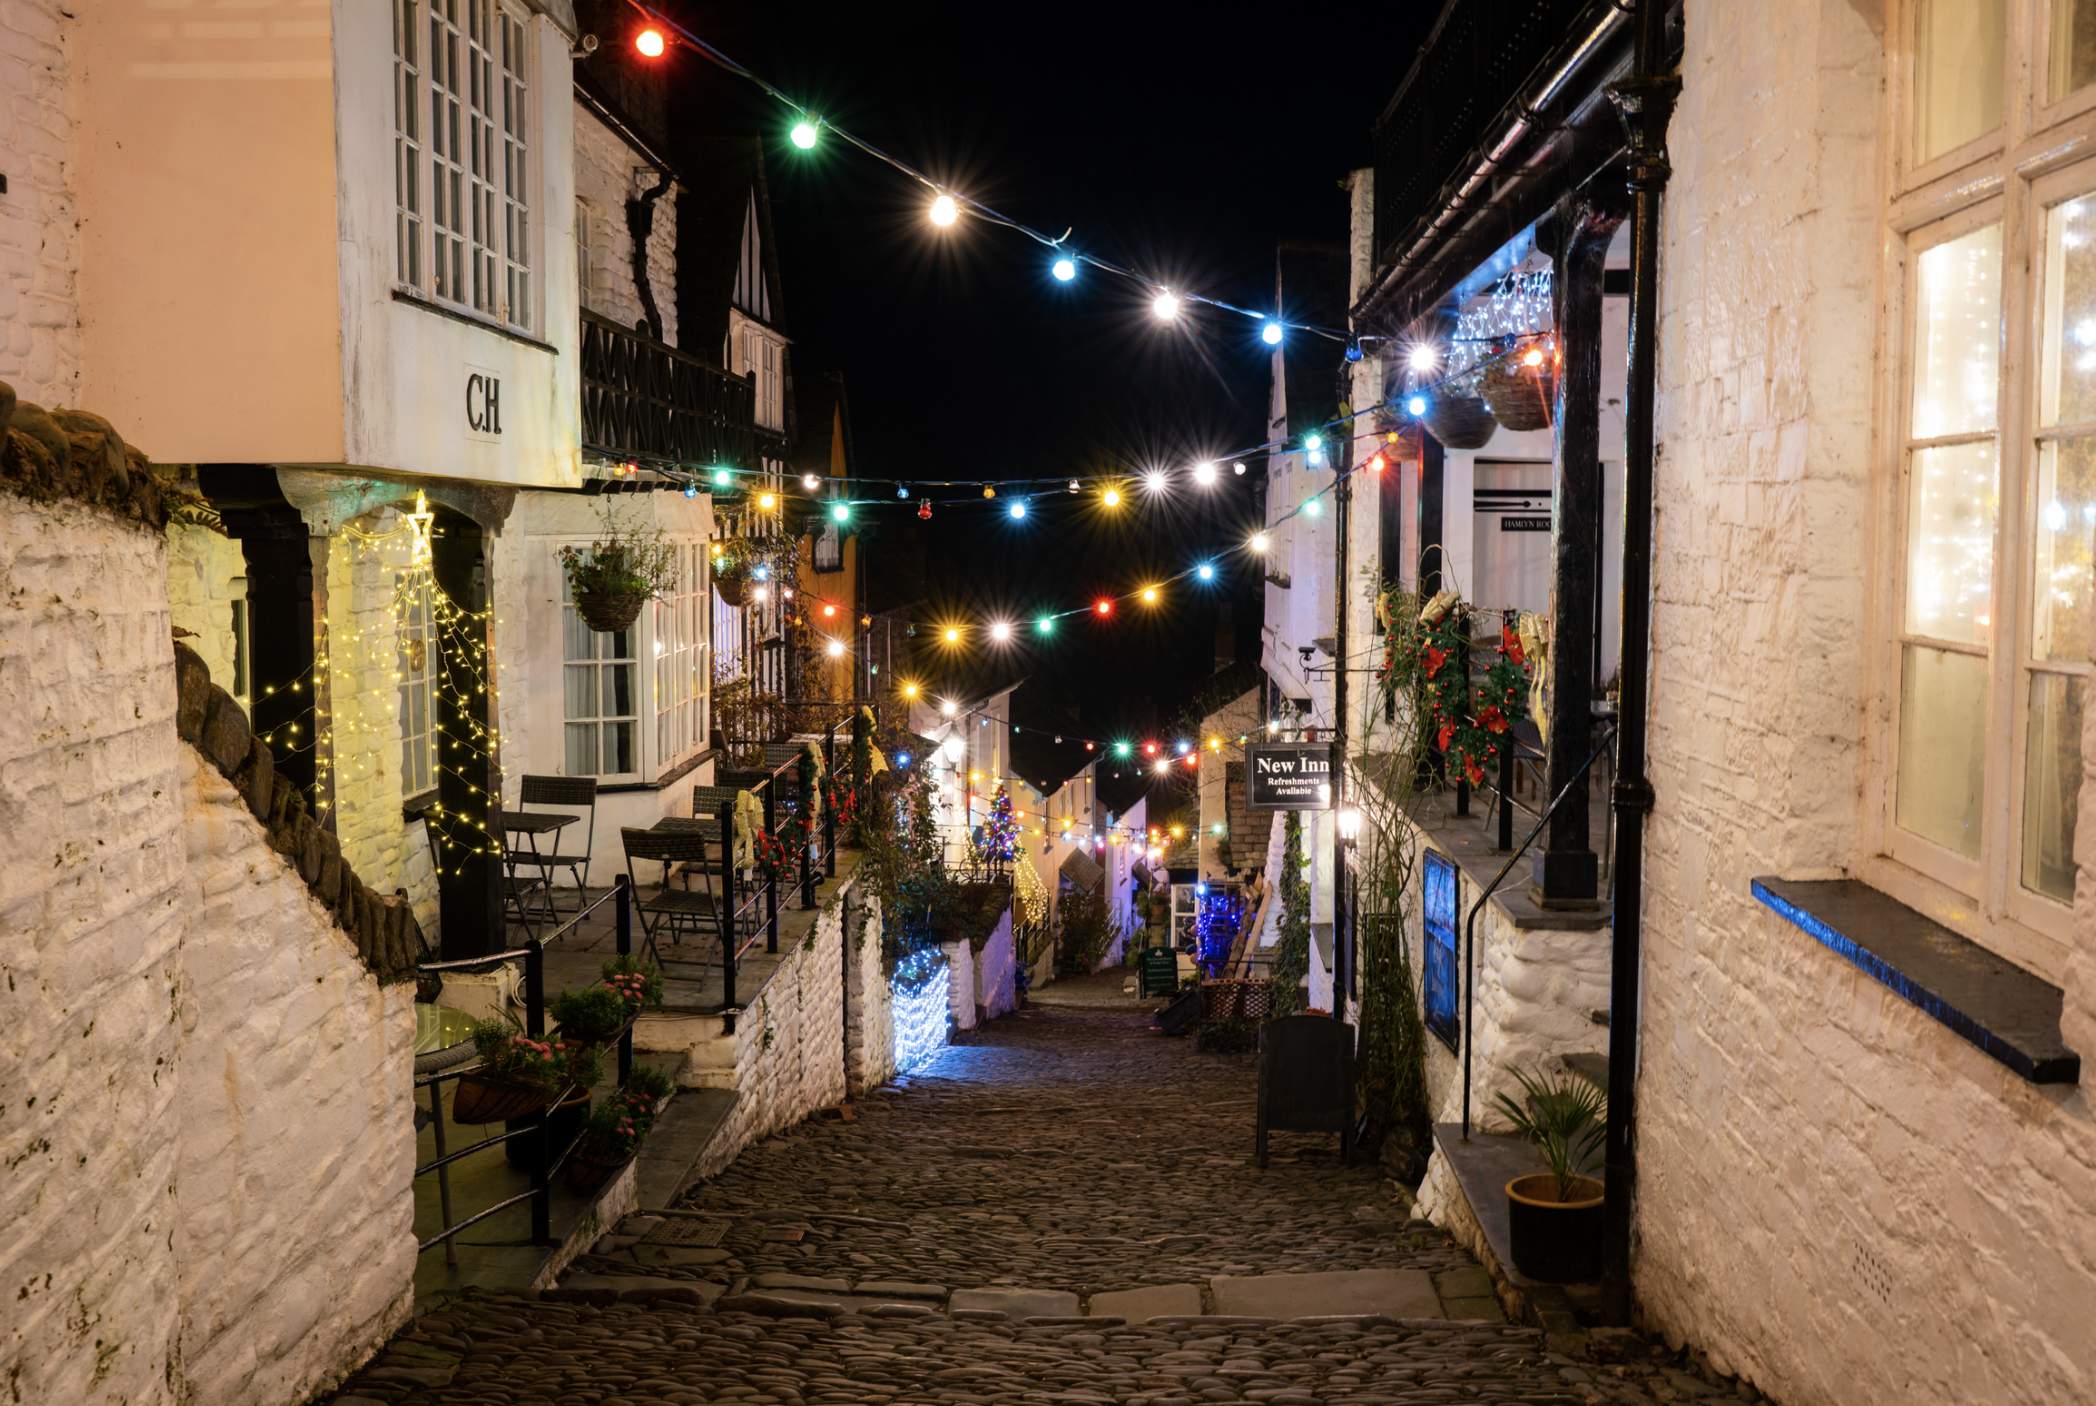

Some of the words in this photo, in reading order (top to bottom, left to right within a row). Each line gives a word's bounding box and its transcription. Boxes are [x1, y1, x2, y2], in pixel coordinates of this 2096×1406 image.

[1504, 519, 1535, 528] HAMLYN
[1257, 757, 1295, 773] New
[1300, 757, 1329, 773] Inn
[1268, 777, 1319, 785] Refreshments
[1276, 787, 1312, 795] Available
